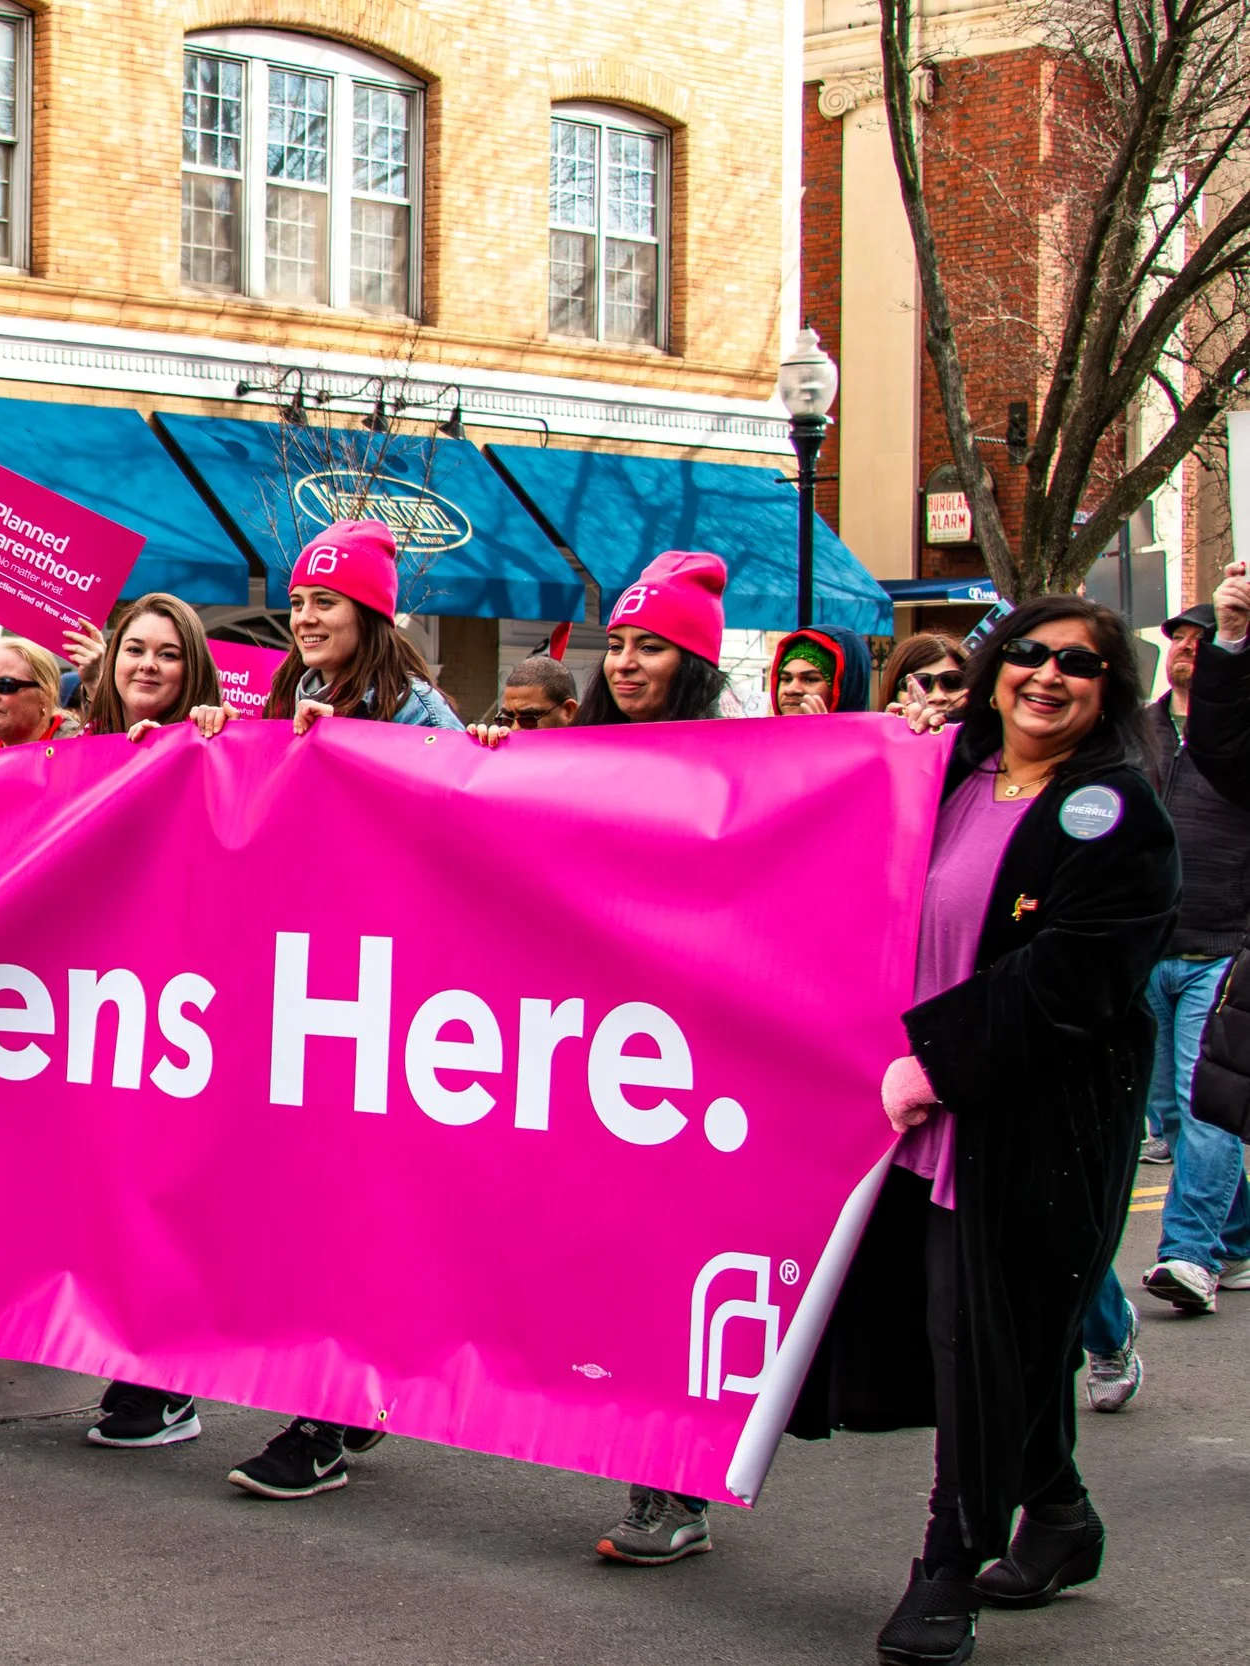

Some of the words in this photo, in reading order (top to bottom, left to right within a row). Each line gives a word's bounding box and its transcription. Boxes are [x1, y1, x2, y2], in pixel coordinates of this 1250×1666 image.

[930, 513, 966, 530] ALARM
[9, 563, 41, 584] matter
[40, 579, 64, 597] what.
[16, 589, 37, 605] Fund
[34, 600, 45, 610] of
[42, 603, 61, 618] New
[1064, 804, 1115, 818] SHERRILL
[268, 930, 749, 1153] Here.
